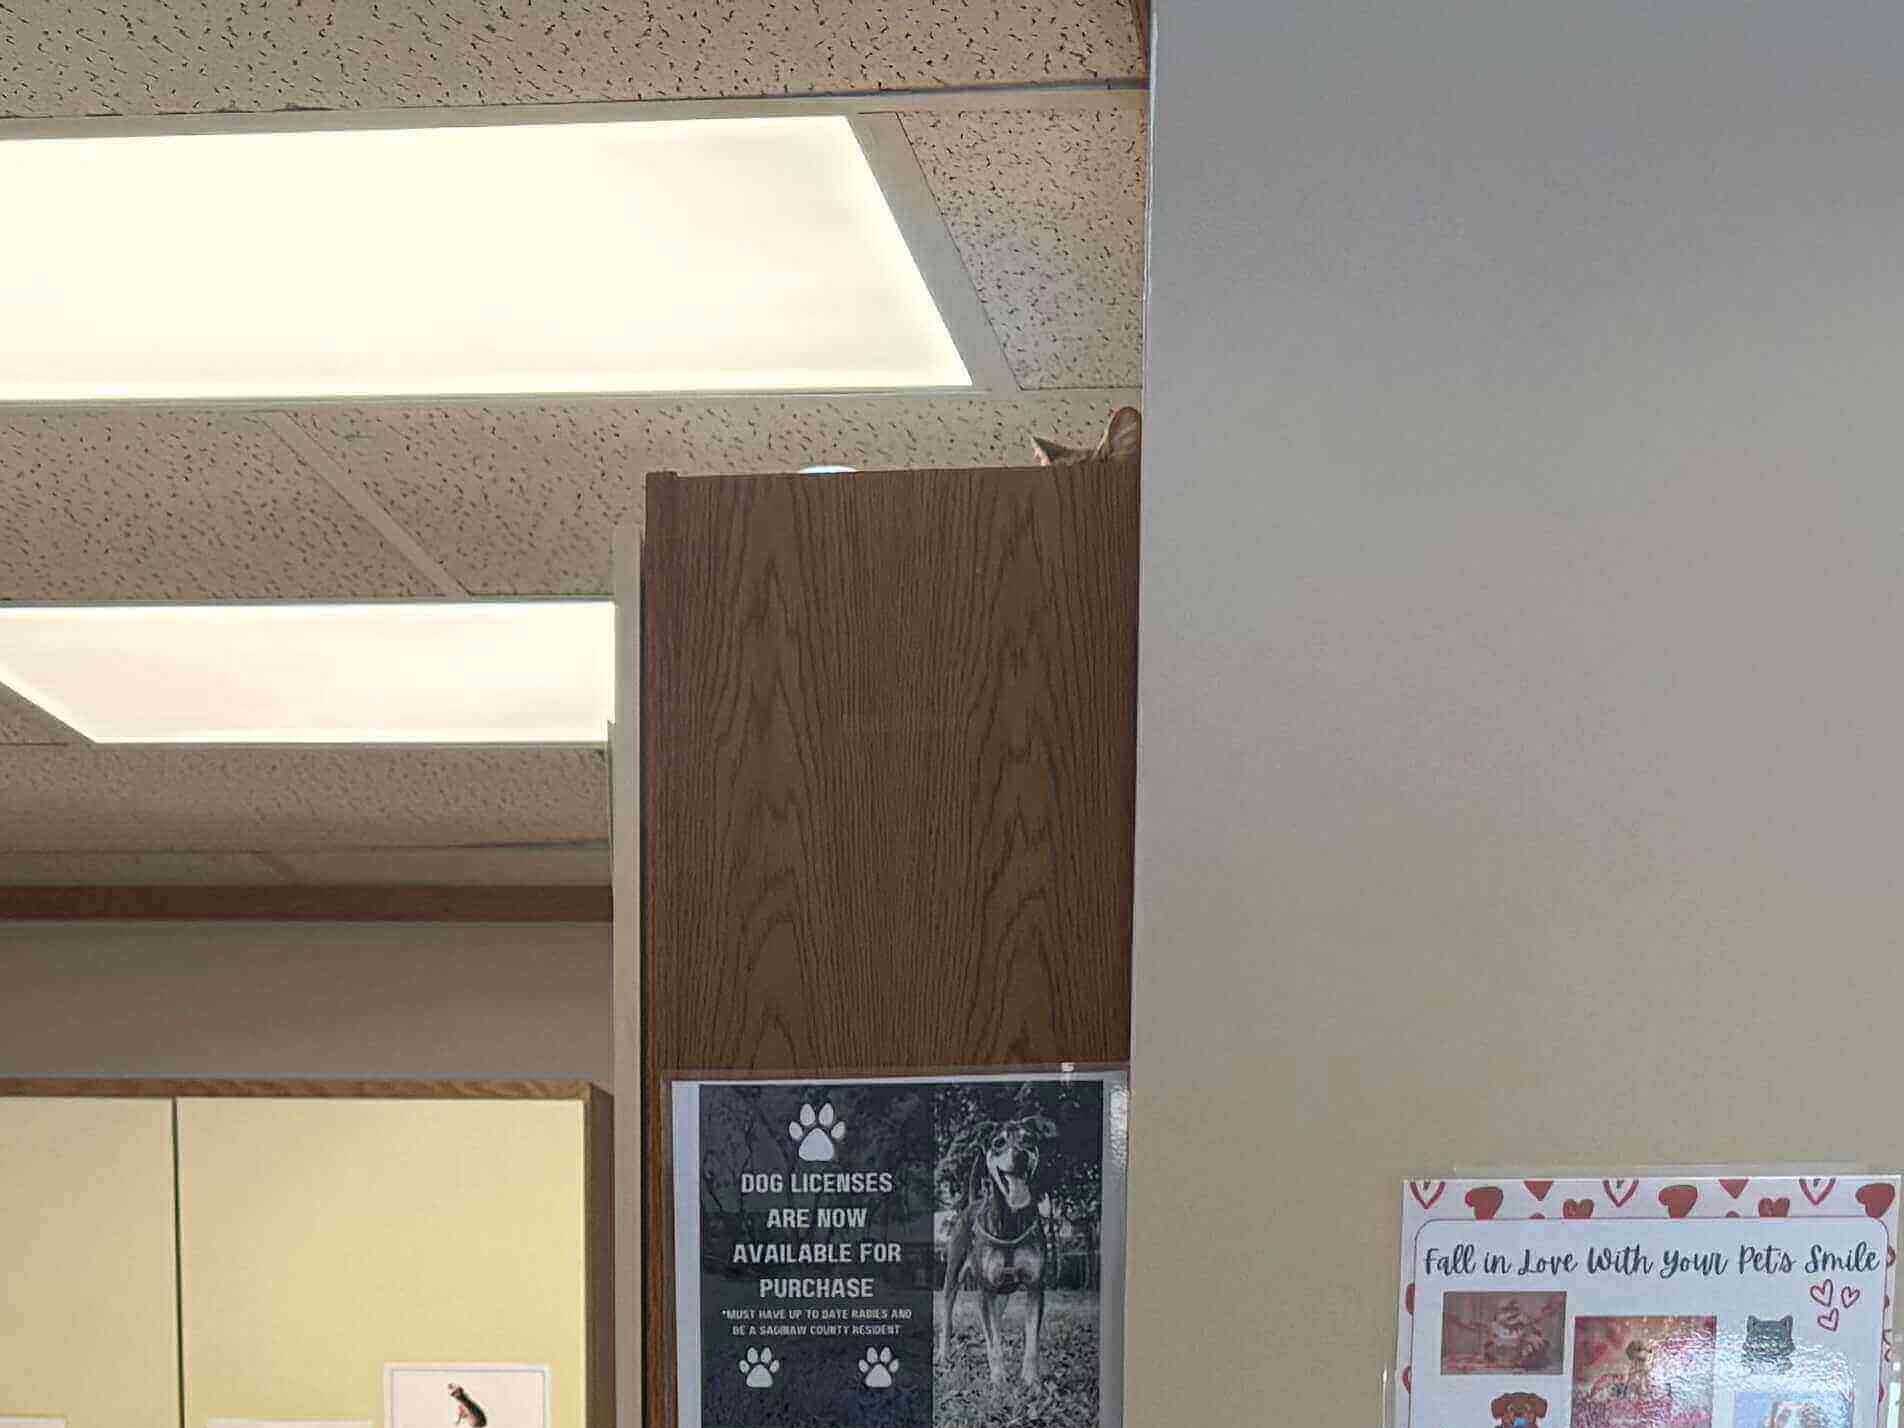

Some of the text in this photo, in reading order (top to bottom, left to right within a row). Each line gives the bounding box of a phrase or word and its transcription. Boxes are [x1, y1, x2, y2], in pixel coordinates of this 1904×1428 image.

[741, 1172, 892, 1193] DOG LICENSES
[767, 1208, 867, 1228] ARE NOW
[733, 1244, 901, 1263] AVAILABLE FOR
[1424, 1242, 1880, 1278] Fall in Love With Your Pet's Smile
[760, 1278, 874, 1298] PURCHASE
[758, 1309, 785, 1320] HAVE
[788, 1309, 802, 1319] UP
[806, 1309, 818, 1319] TO
[822, 1309, 849, 1320] DATE
[851, 1309, 888, 1319] RABIES
[891, 1309, 912, 1319] AND
[733, 1325, 746, 1336] BE
[748, 1325, 756, 1336] A
[810, 1325, 849, 1336] COUNTY
[852, 1325, 901, 1336] RESIDENT
